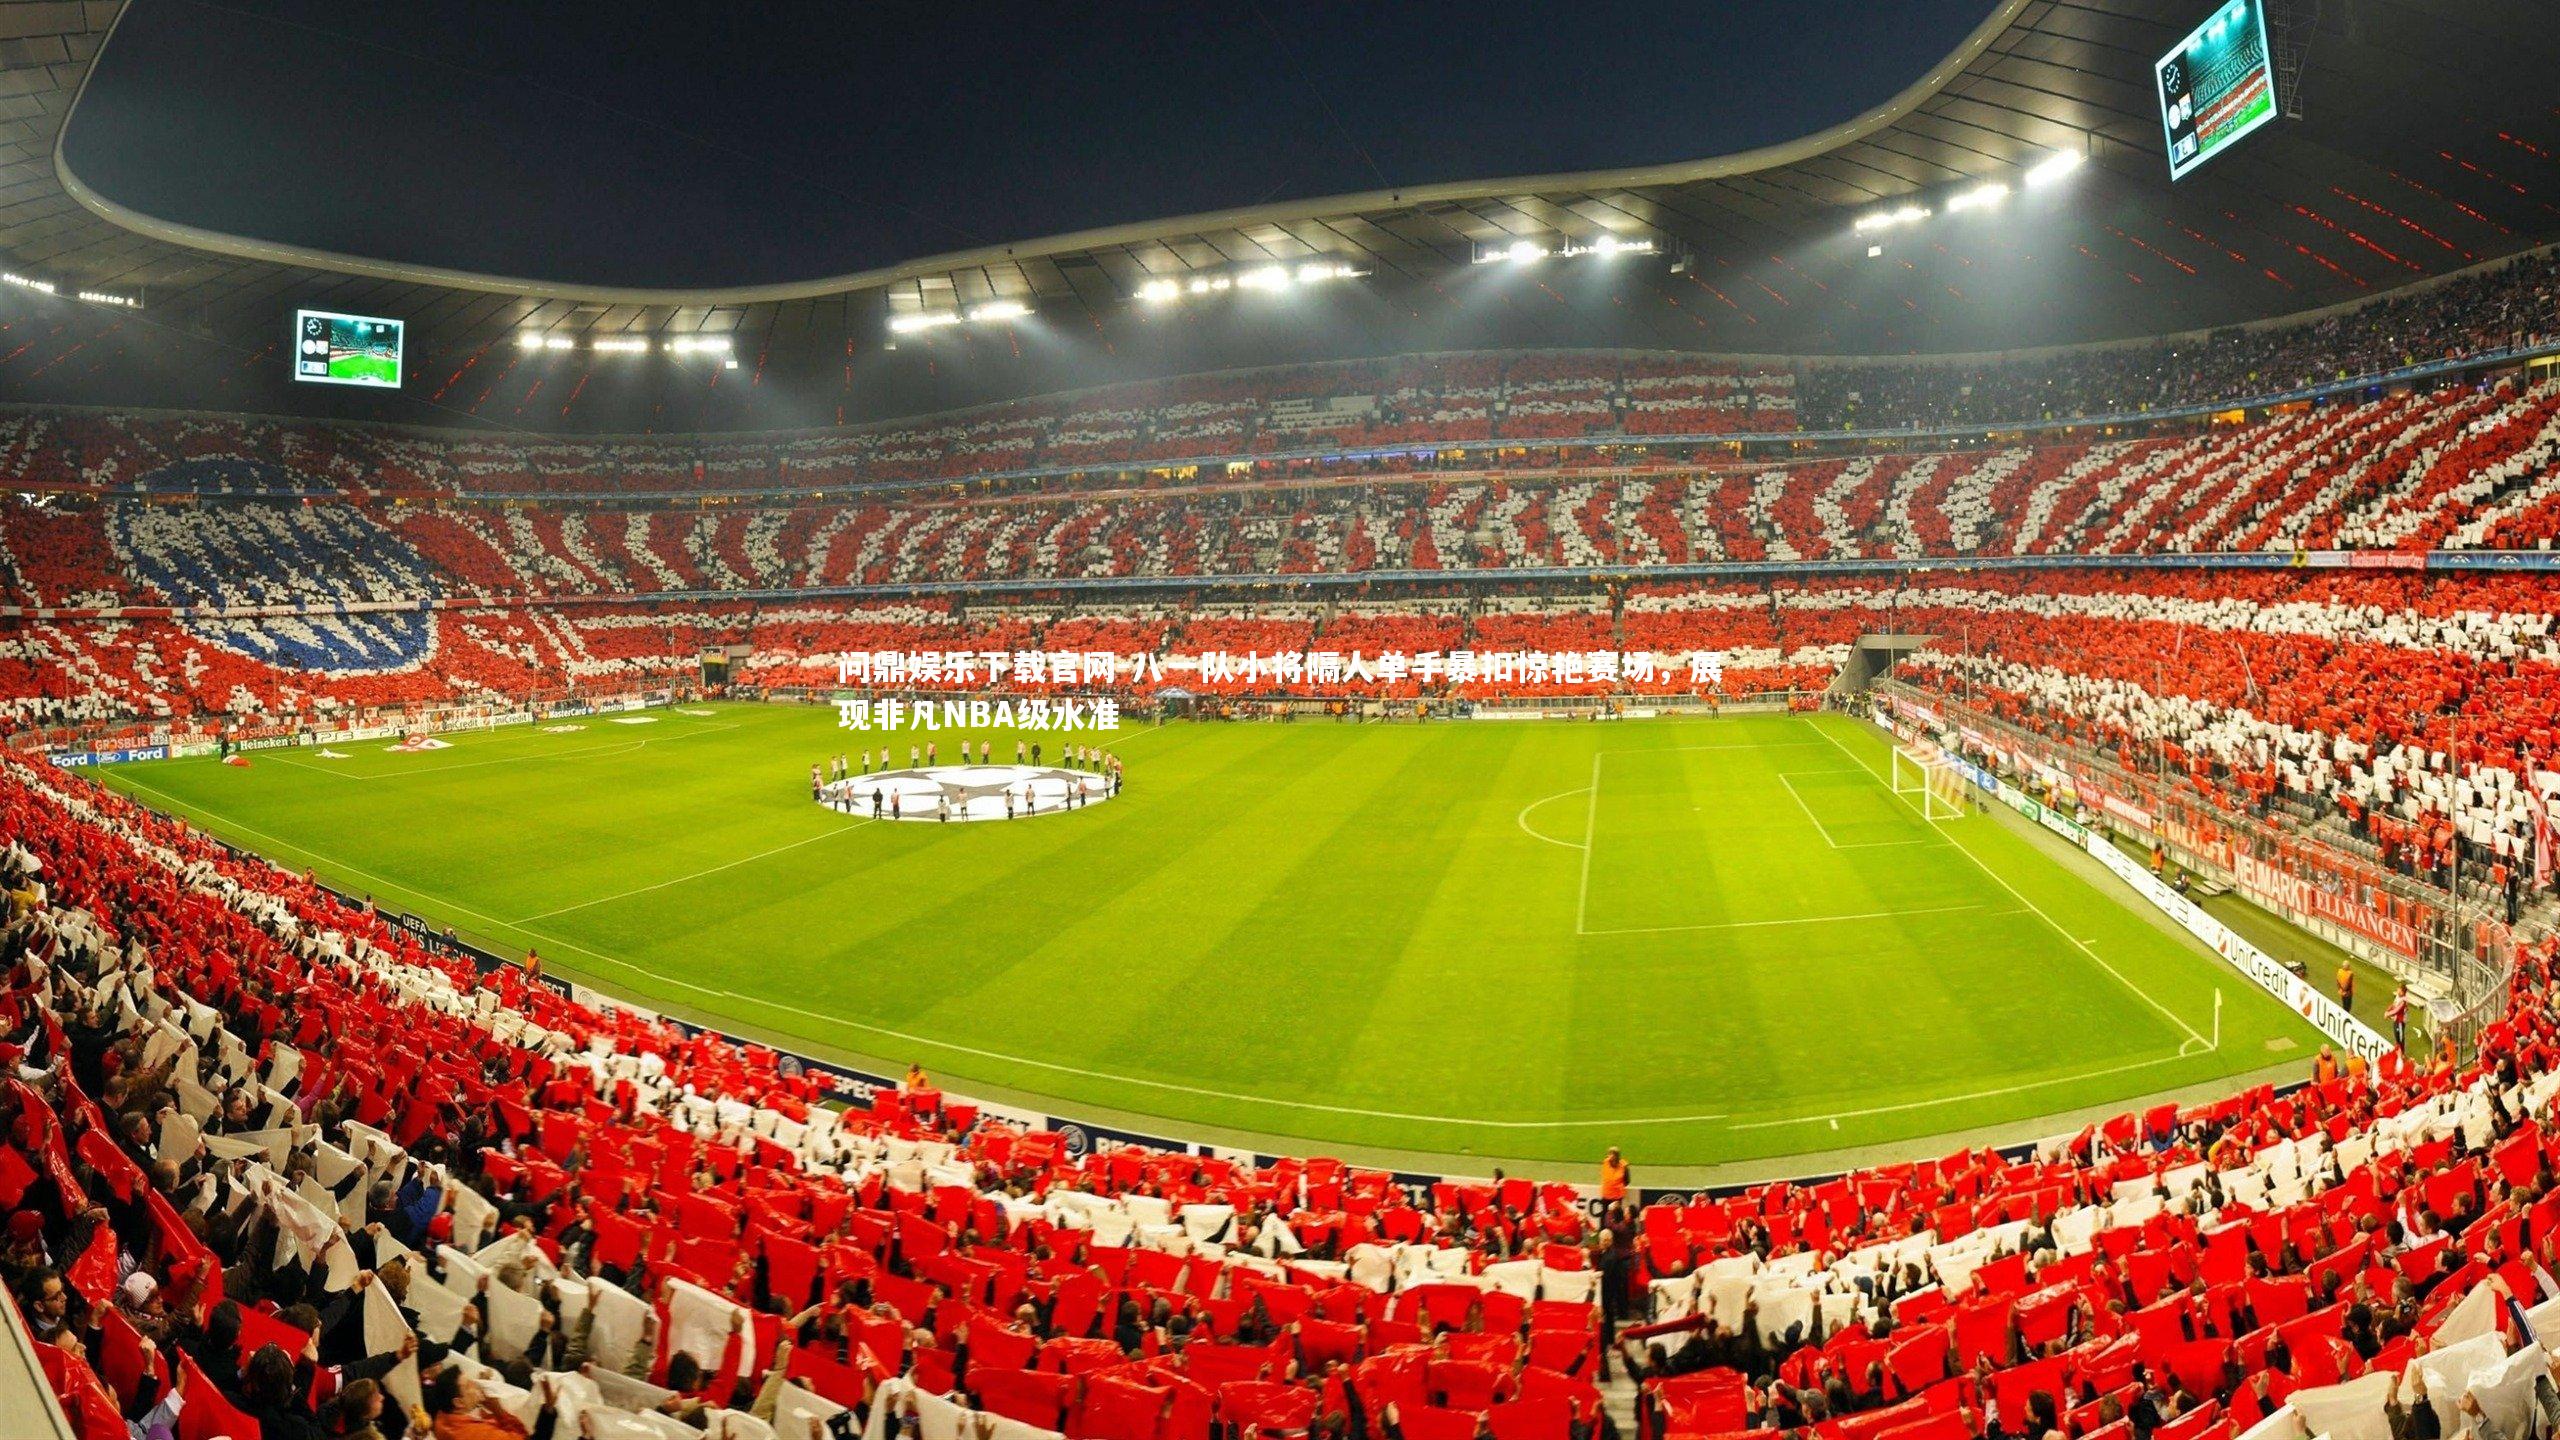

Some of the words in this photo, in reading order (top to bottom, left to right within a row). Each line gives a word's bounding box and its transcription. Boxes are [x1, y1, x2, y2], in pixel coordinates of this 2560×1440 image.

[52, 754, 88, 767] Ford
[129, 748, 163, 761] Ford
[241, 738, 288, 751] Heineken
[2234, 852, 2313, 916] NEUMARKT
[402, 915, 428, 935] UEFA
[2316, 897, 2415, 954] ELLWANGEN
[2230, 934, 2290, 1001] UniCredit
